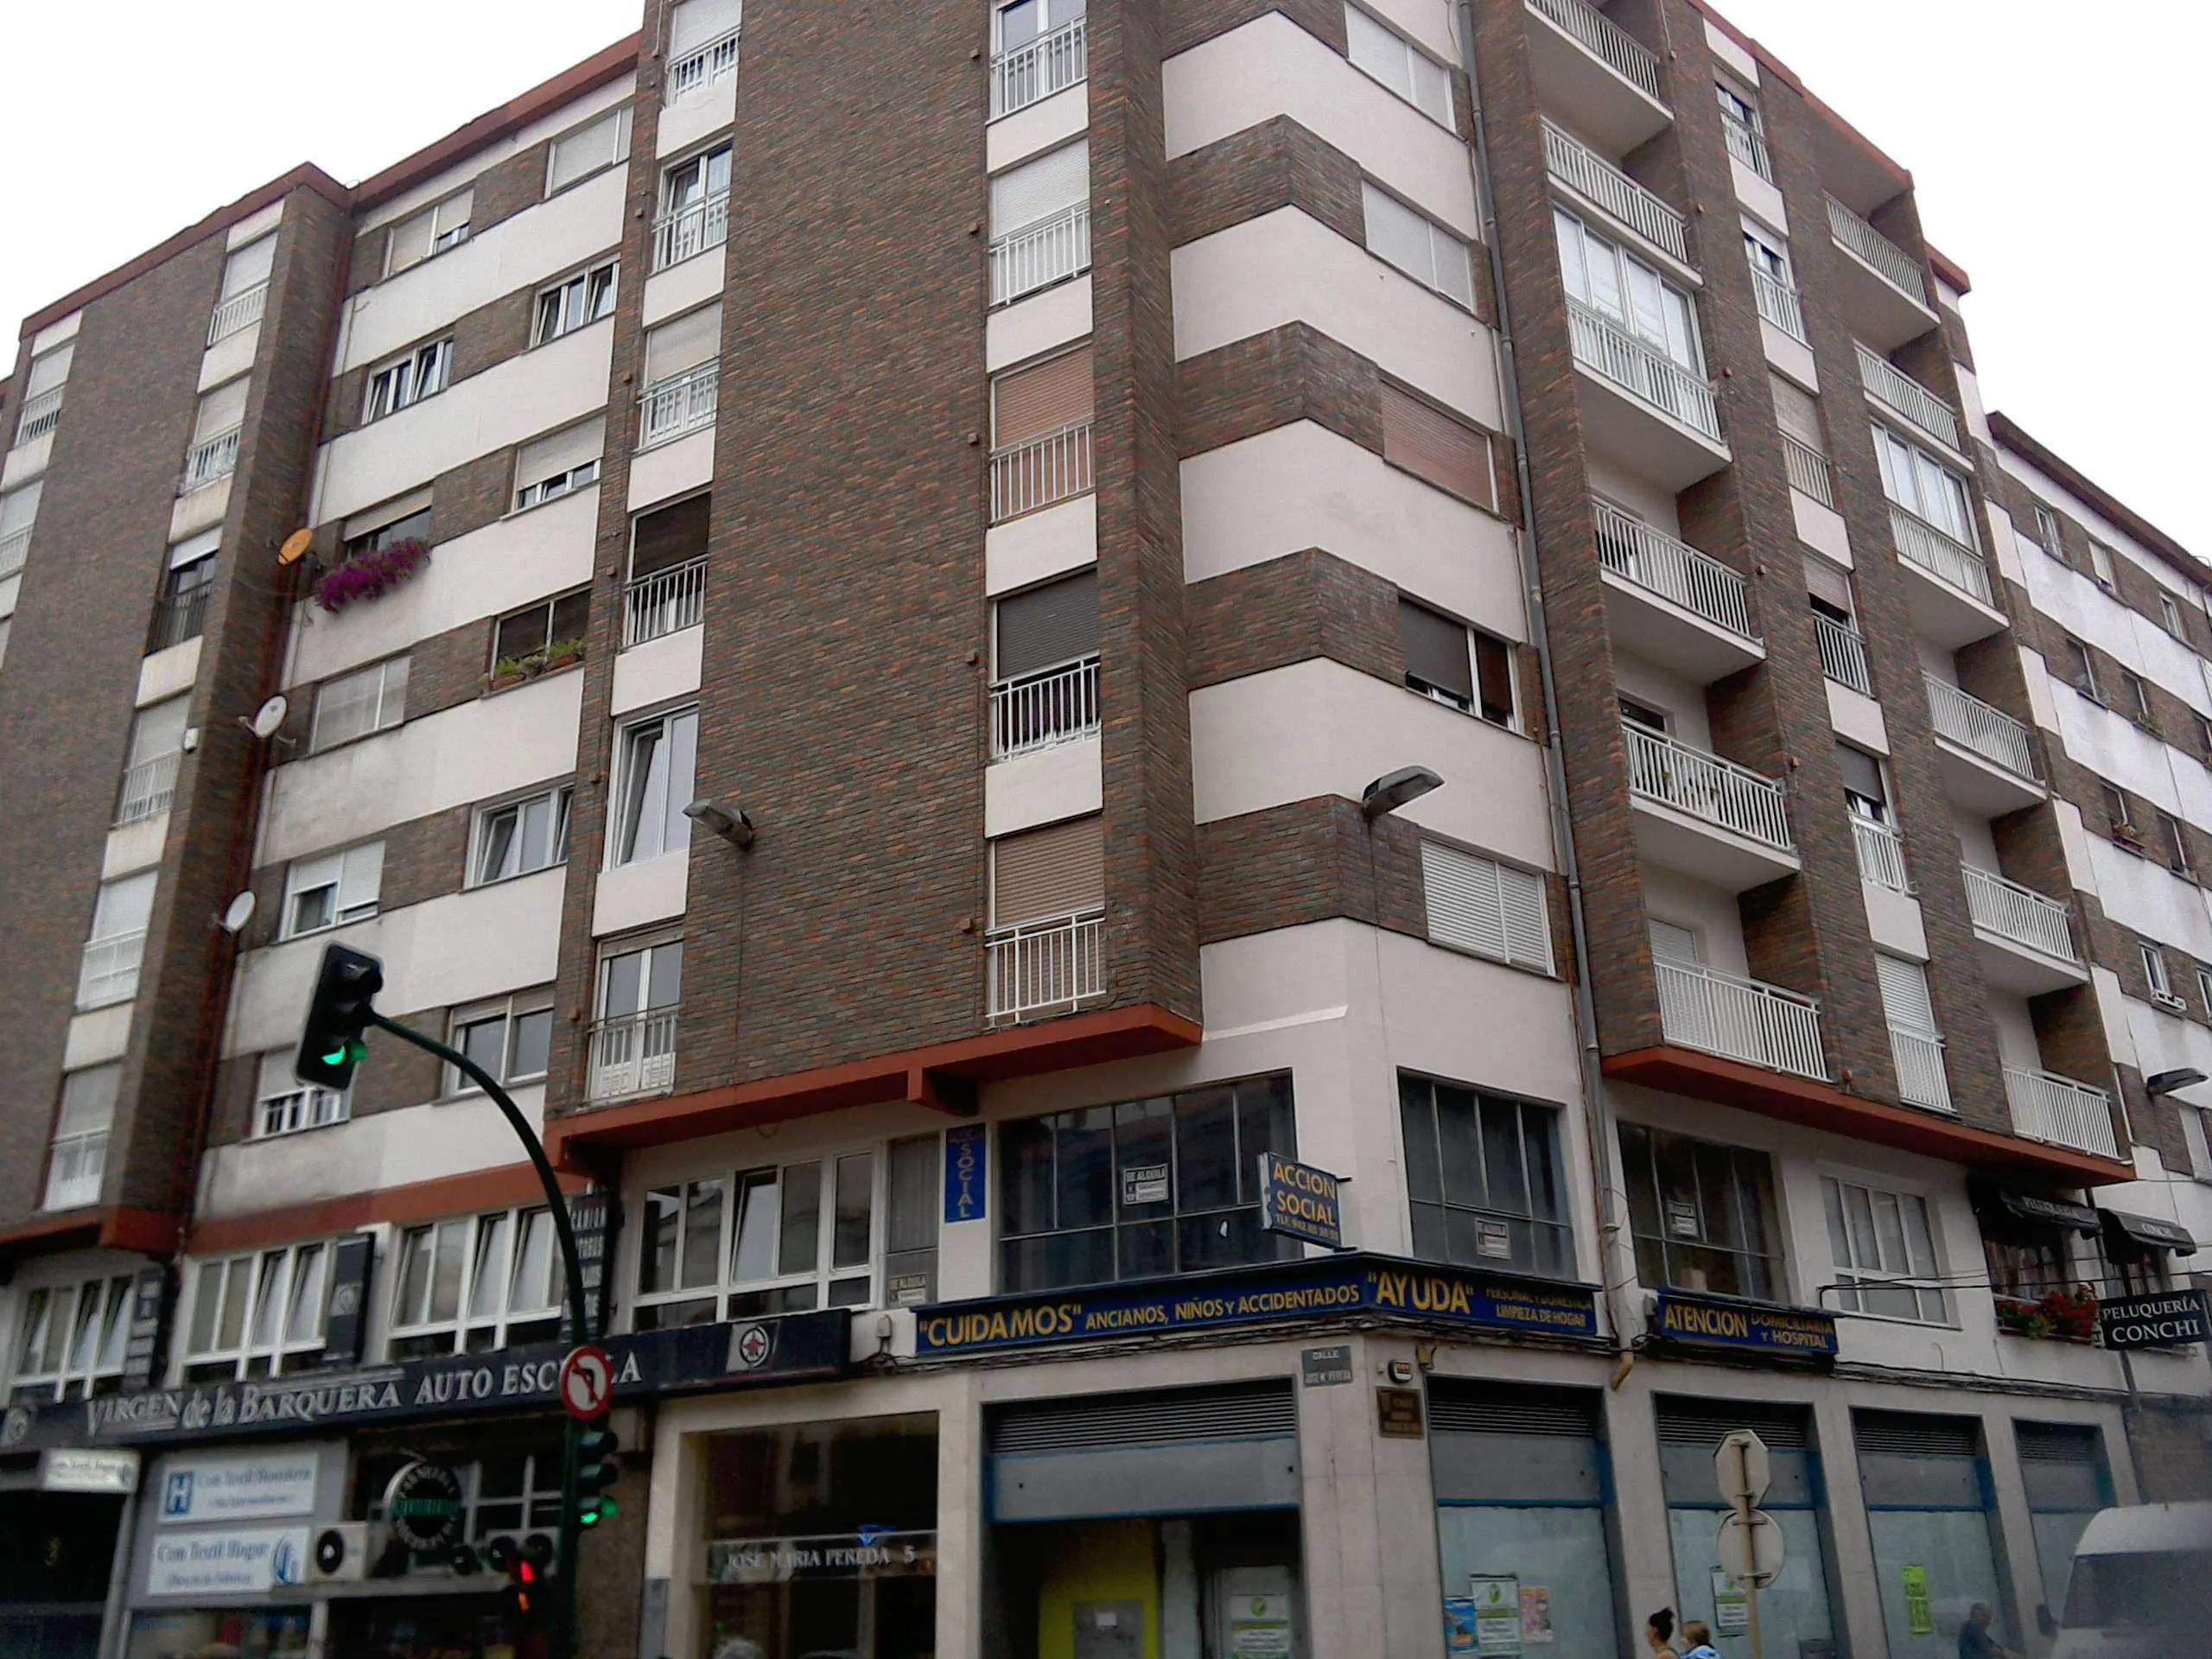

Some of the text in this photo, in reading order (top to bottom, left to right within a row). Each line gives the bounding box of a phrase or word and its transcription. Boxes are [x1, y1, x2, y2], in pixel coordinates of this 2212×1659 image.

[957, 1141, 975, 1218] SOCIAL
[1274, 1160, 1335, 1198] ACCION
[1277, 1190, 1336, 1226] SOCIAL
[1369, 1271, 1474, 1315] "AYUDA"
[2102, 1295, 2201, 1321] PELUQUERÍA
[919, 1303, 1082, 1347] "CUIDAMOS"
[1085, 1305, 1169, 1331] ANCIANOS,
[1175, 1297, 1224, 1321] NIÑOS
[1237, 1284, 1360, 1314] ACCIDENTADOS
[1664, 1304, 1749, 1338] ATENCION
[2111, 1319, 2202, 1343] CONCHI
[1773, 1330, 1829, 1349] HOSPITAL
[87, 1391, 183, 1437] VIRGEN
[238, 1381, 402, 1424] BARQUERA
[414, 1366, 494, 1405] AUTO
[500, 1351, 643, 1395] ESCA
[825, 1545, 891, 1567] PEREDA
[903, 1543, 917, 1564] 5
